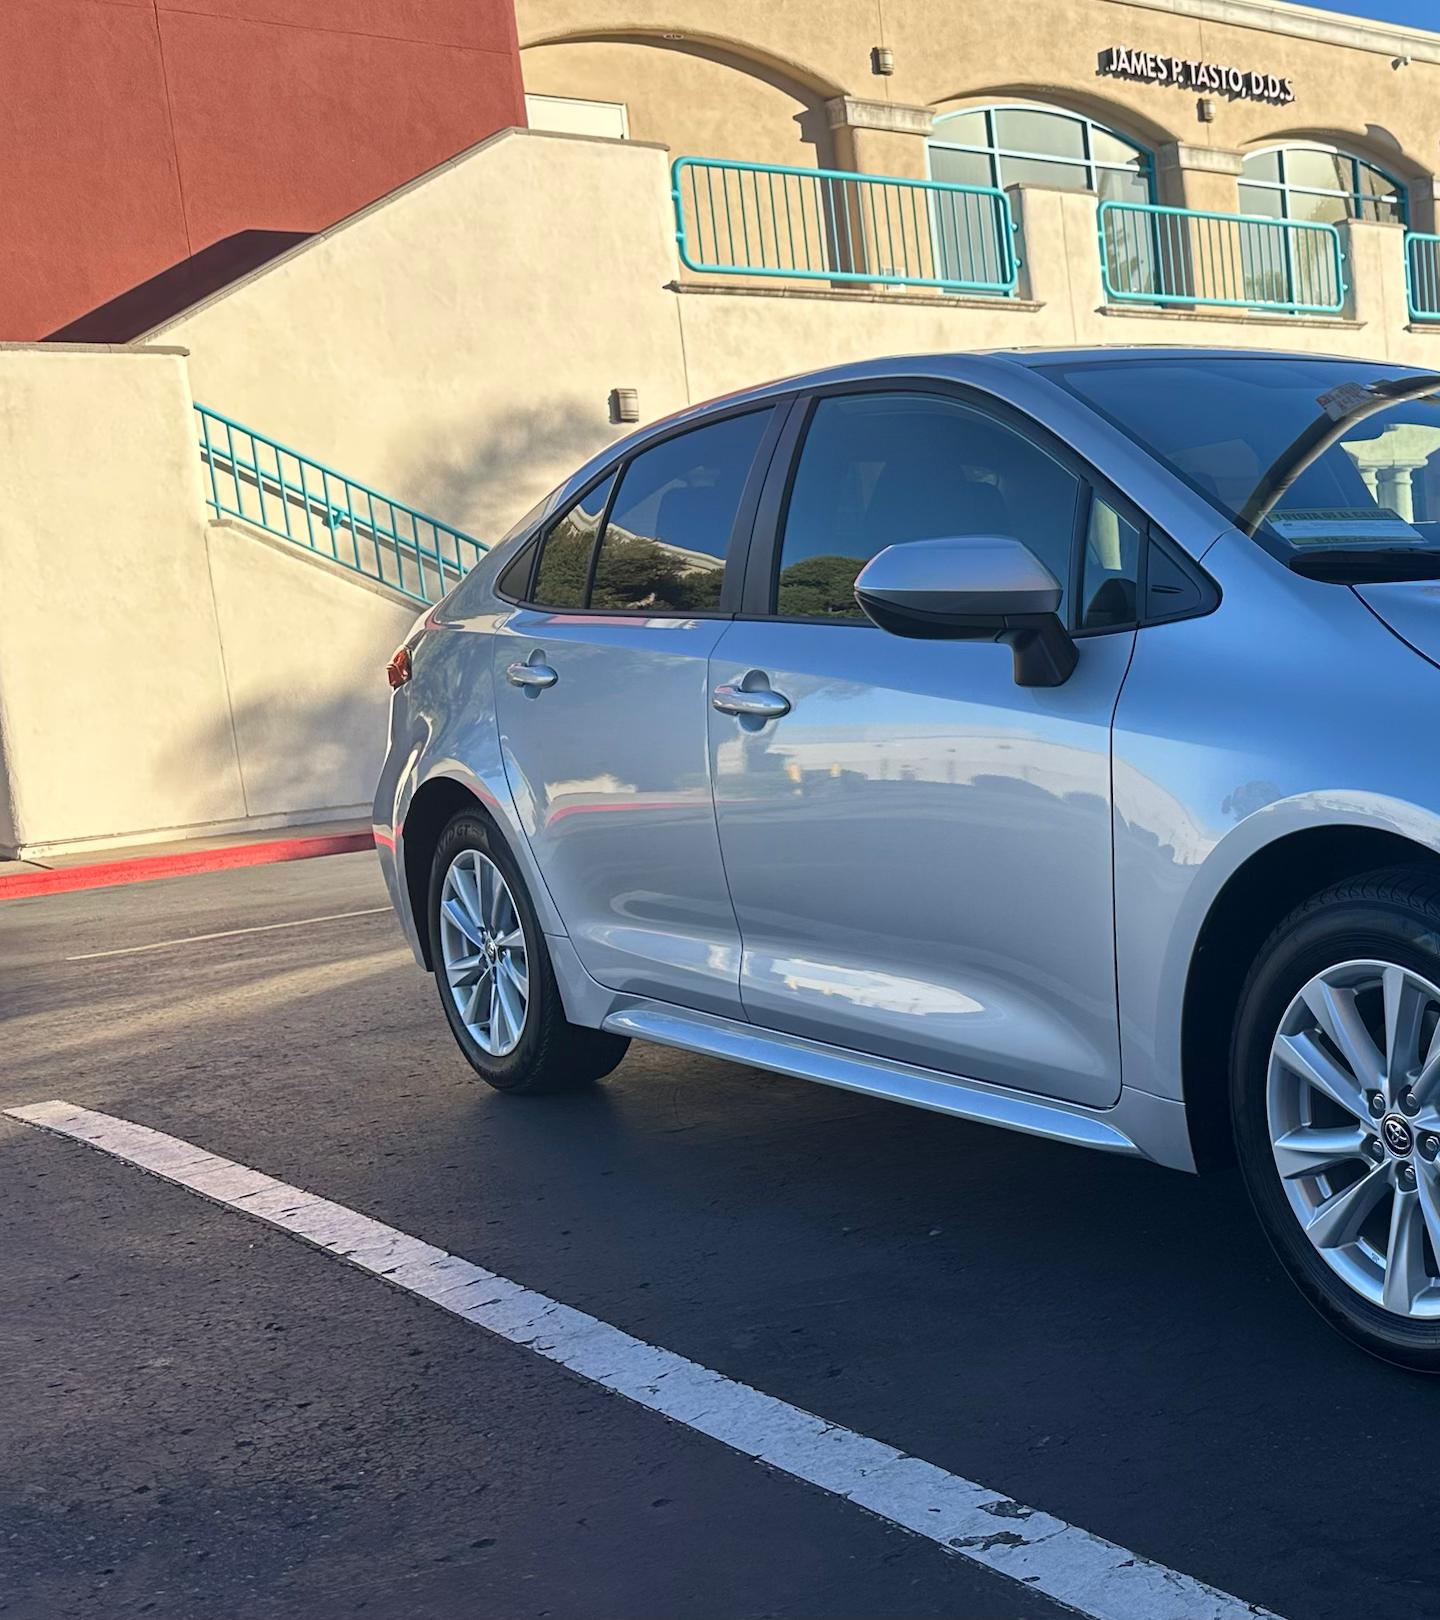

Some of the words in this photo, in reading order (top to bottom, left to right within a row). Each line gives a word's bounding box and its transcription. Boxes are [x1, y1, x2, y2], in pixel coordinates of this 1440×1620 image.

[1109, 46, 1167, 80] JAMES
[1172, 60, 1184, 83] P.
[1187, 61, 1246, 97] TASTO,
